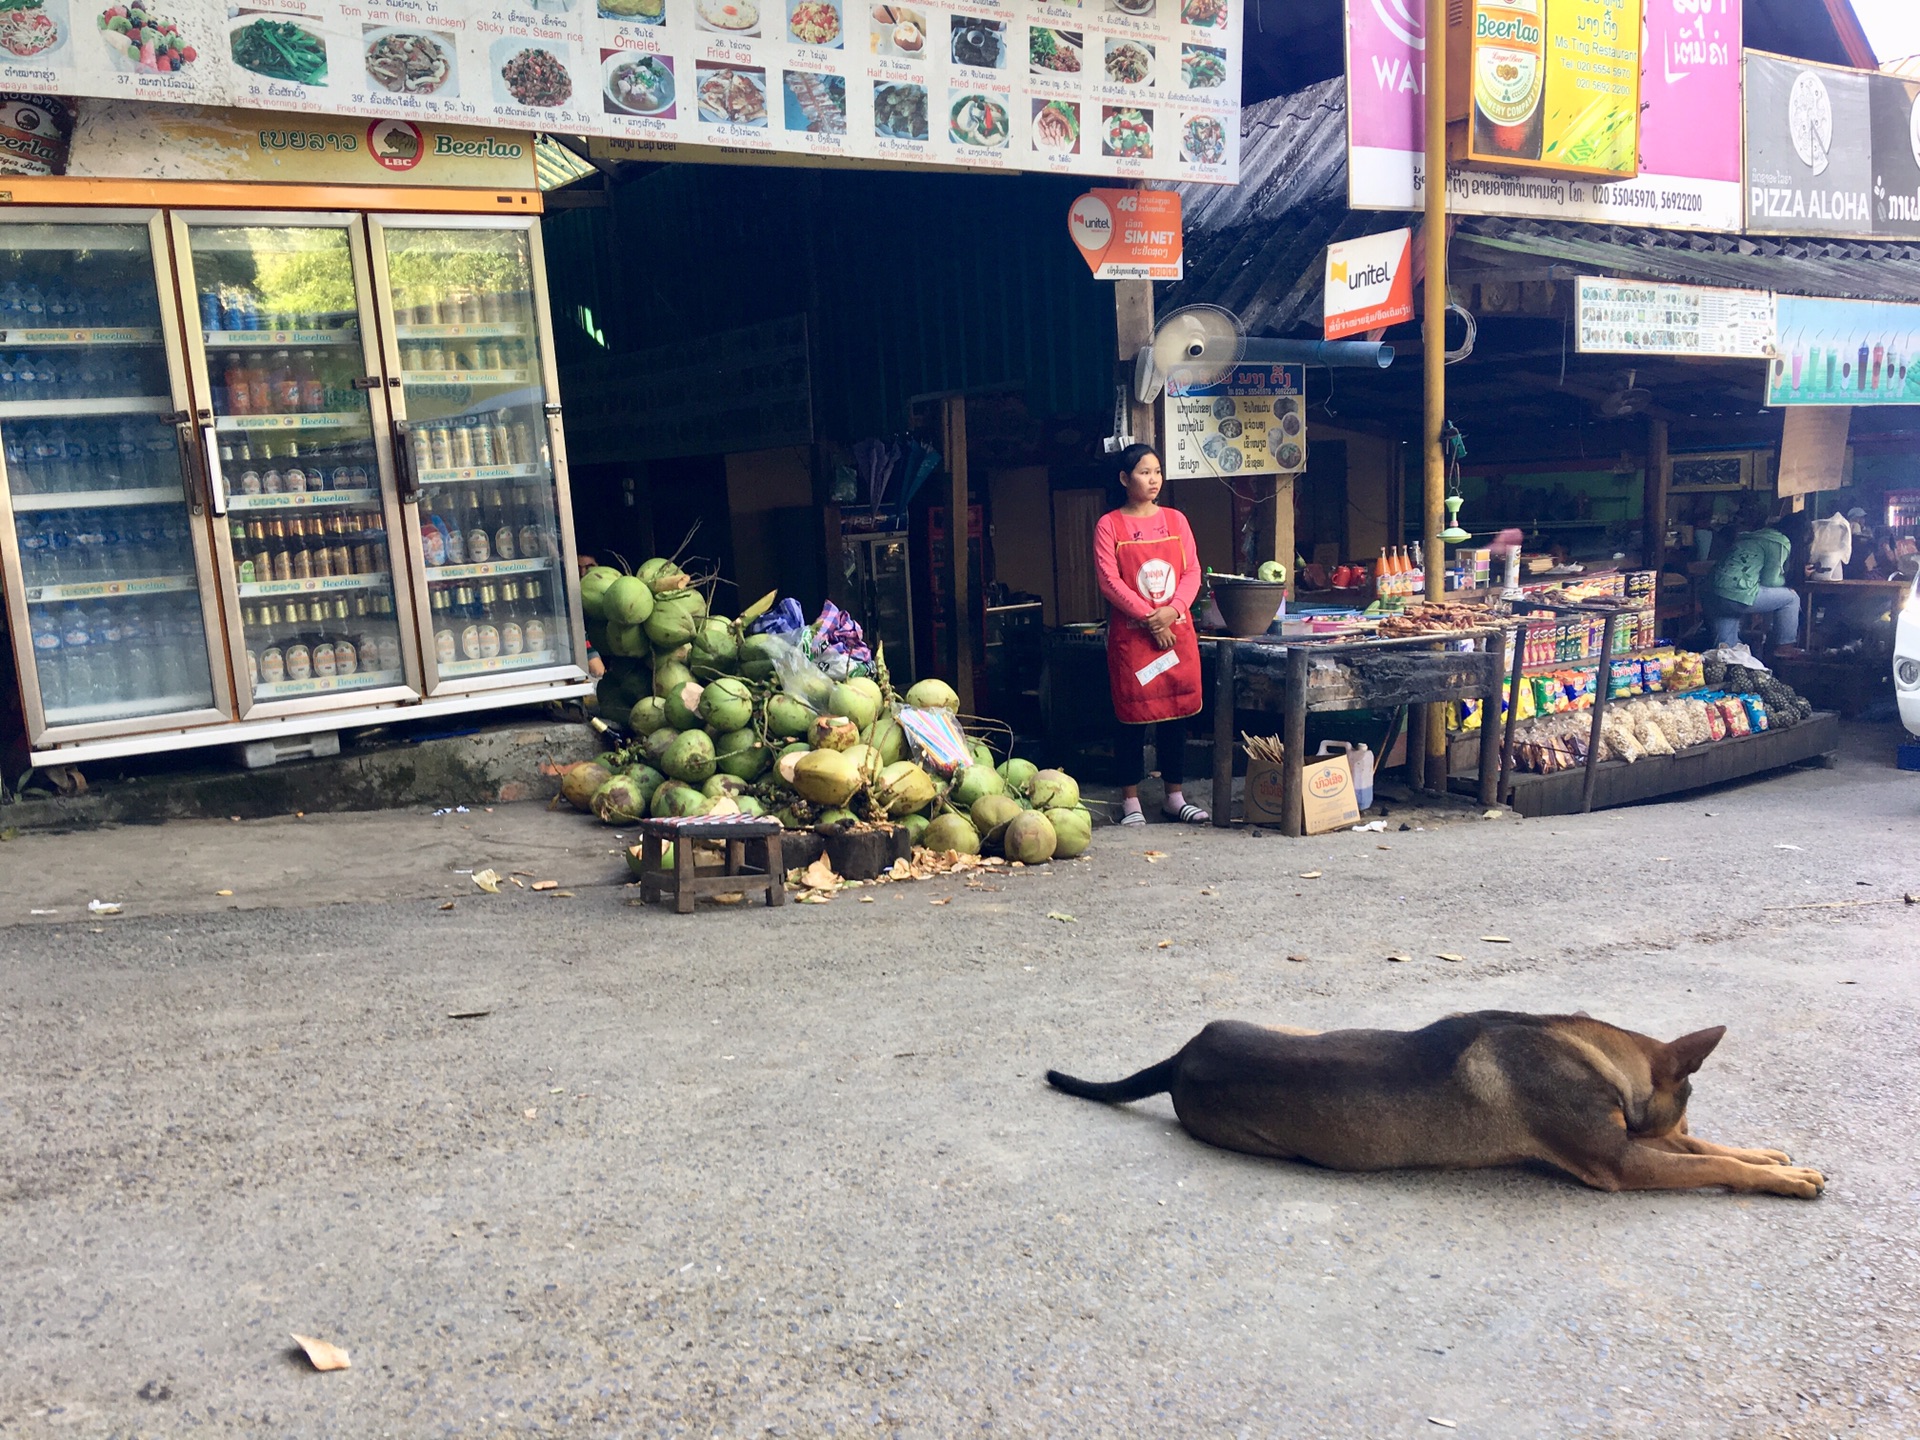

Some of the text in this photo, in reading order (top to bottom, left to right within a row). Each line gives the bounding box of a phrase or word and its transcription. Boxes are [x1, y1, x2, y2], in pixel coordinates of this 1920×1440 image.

[339, 5, 362, 16] Tom
[367, 10, 390, 21] yam
[426, 14, 467, 30] chicken)
[1577, 15, 1600, 37] ນາງ
[476, 20, 505, 34] Sticky
[533, 27, 562, 40] Steam
[566, 32, 584, 42] rice
[1476, 12, 1540, 43] Beerlao
[706, 47, 752, 64] Fried egg
[1592, 42, 1638, 62] Restaurant
[866, 68, 925, 85] Half boiled egg
[1371, 54, 1425, 95] WA
[1576, 62, 1592, 72] 020
[1593, 64, 1611, 75] 5554
[1613, 67, 1631, 79] 5970
[32, 83, 59, 92] salad
[135, 88, 162, 97] Mixed
[950, 77, 1011, 93] Fried river weed
[1576, 78, 1591, 89] 020
[1612, 83, 1631, 95] 2200
[263, 99, 298, 109] morning
[301, 102, 322, 111] glory
[336, 103, 357, 113] Fried
[360, 106, 401, 117] mushroom
[404, 109, 420, 118] with
[1506, 92, 1535, 118] COMPANY
[258, 129, 359, 152] ເບຍລາວ
[624, 126, 678, 140] Kao soup
[434, 135, 523, 159] Beerlao
[21, 160, 46, 173] Beer
[384, 158, 412, 167] LBC
[1117, 167, 1145, 177] Barbecue
[1117, 196, 1137, 212] 4G
[1592, 184, 1610, 204] 020
[1612, 185, 1659, 211] 55045970,
[1660, 190, 1703, 212] 56922200
[1751, 187, 1870, 220] PIZZA ALOHA
[1085, 216, 1110, 229] unitel
[1124, 230, 1175, 245] SIM NET
[1348, 261, 1391, 290] unitel
